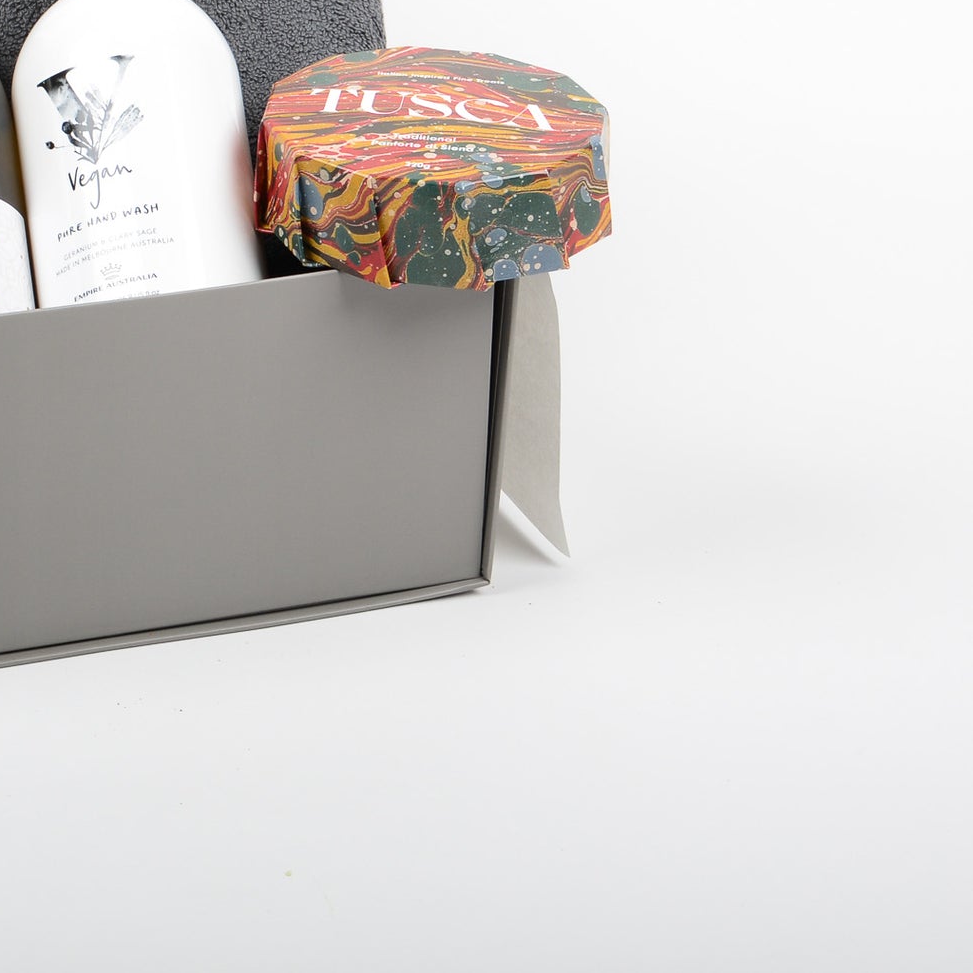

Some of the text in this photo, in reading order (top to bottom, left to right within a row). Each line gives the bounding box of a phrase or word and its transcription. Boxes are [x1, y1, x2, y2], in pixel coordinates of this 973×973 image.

[310, 88, 555, 132] TUSCA
[370, 140, 422, 148] Panforte
[67, 164, 132, 209] Vegan
[57, 203, 159, 242] PURE HAND WASH
[136, 227, 158, 237] SAGE
[130, 237, 176, 249] AUSTRALIA
[73, 285, 103, 303] EMPIRE
[106, 273, 159, 289] AUSTRALIA
